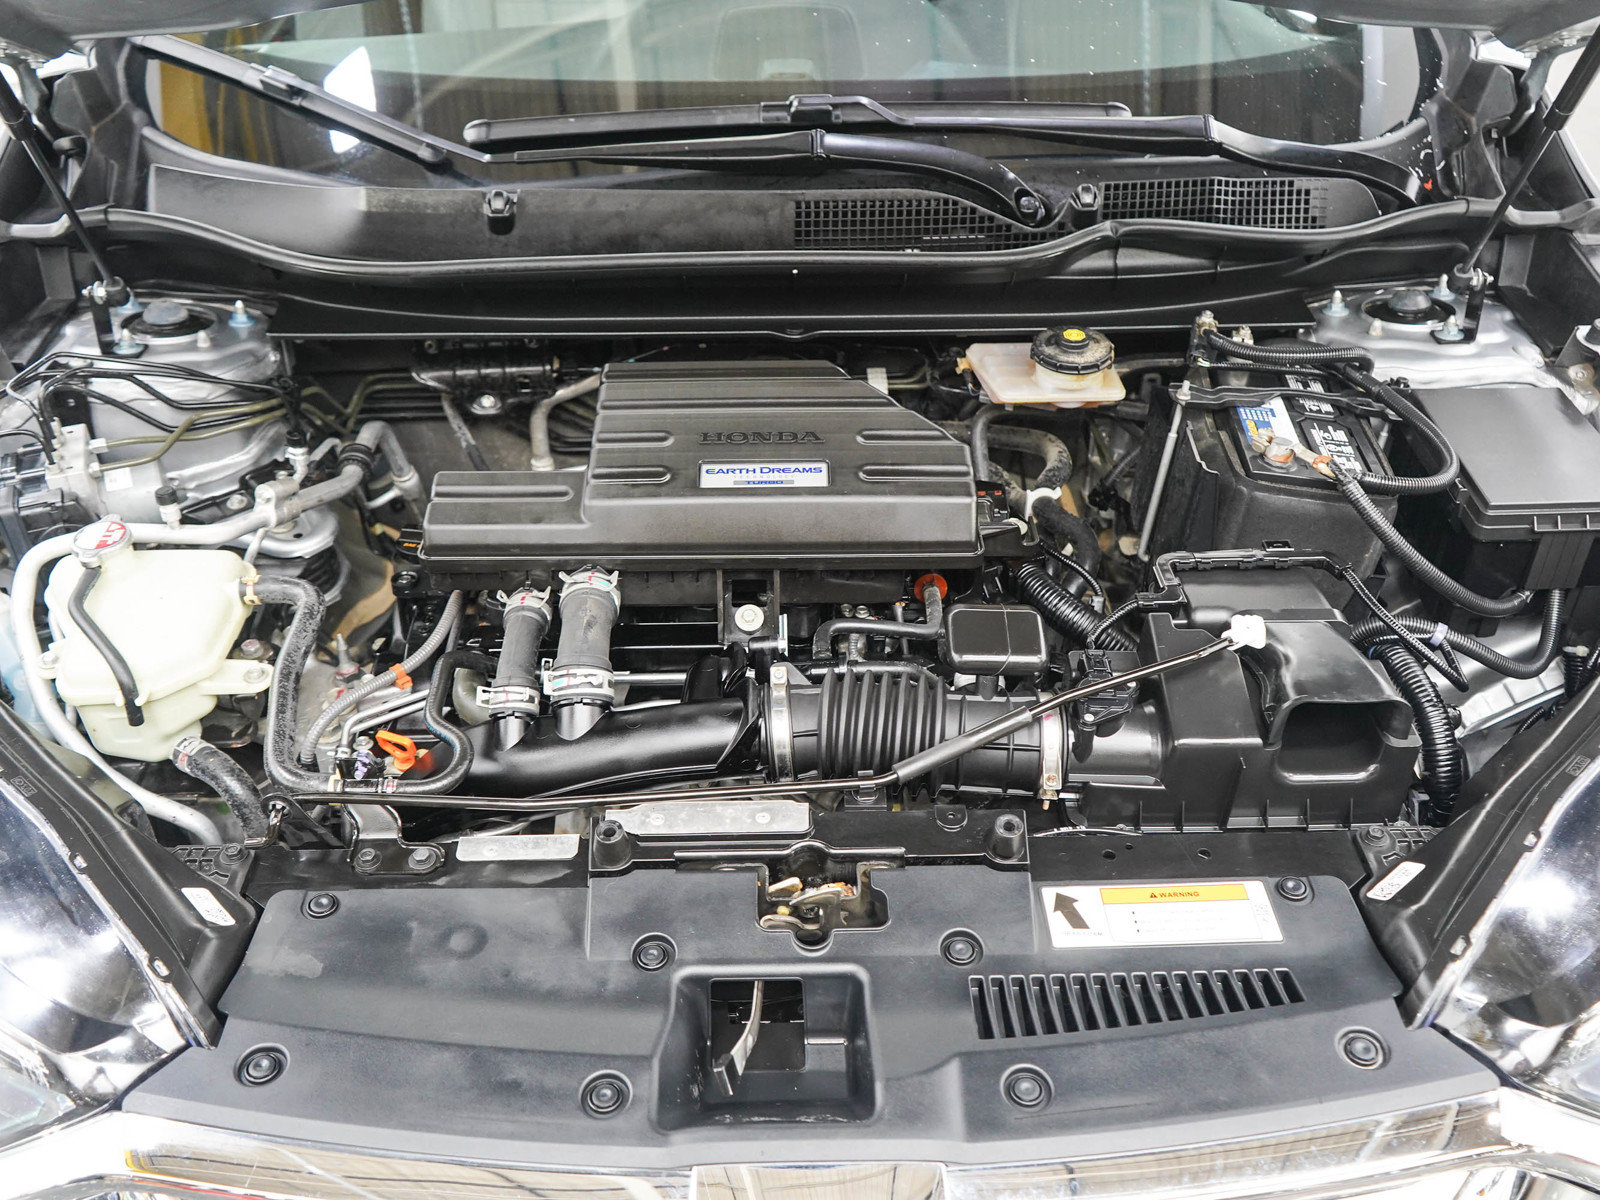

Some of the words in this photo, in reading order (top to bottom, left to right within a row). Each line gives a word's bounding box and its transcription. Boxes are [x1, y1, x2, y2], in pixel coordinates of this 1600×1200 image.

[699, 431, 825, 444] HONDA
[705, 467, 756, 475] EARTH
[759, 466, 823, 474] DREAMS
